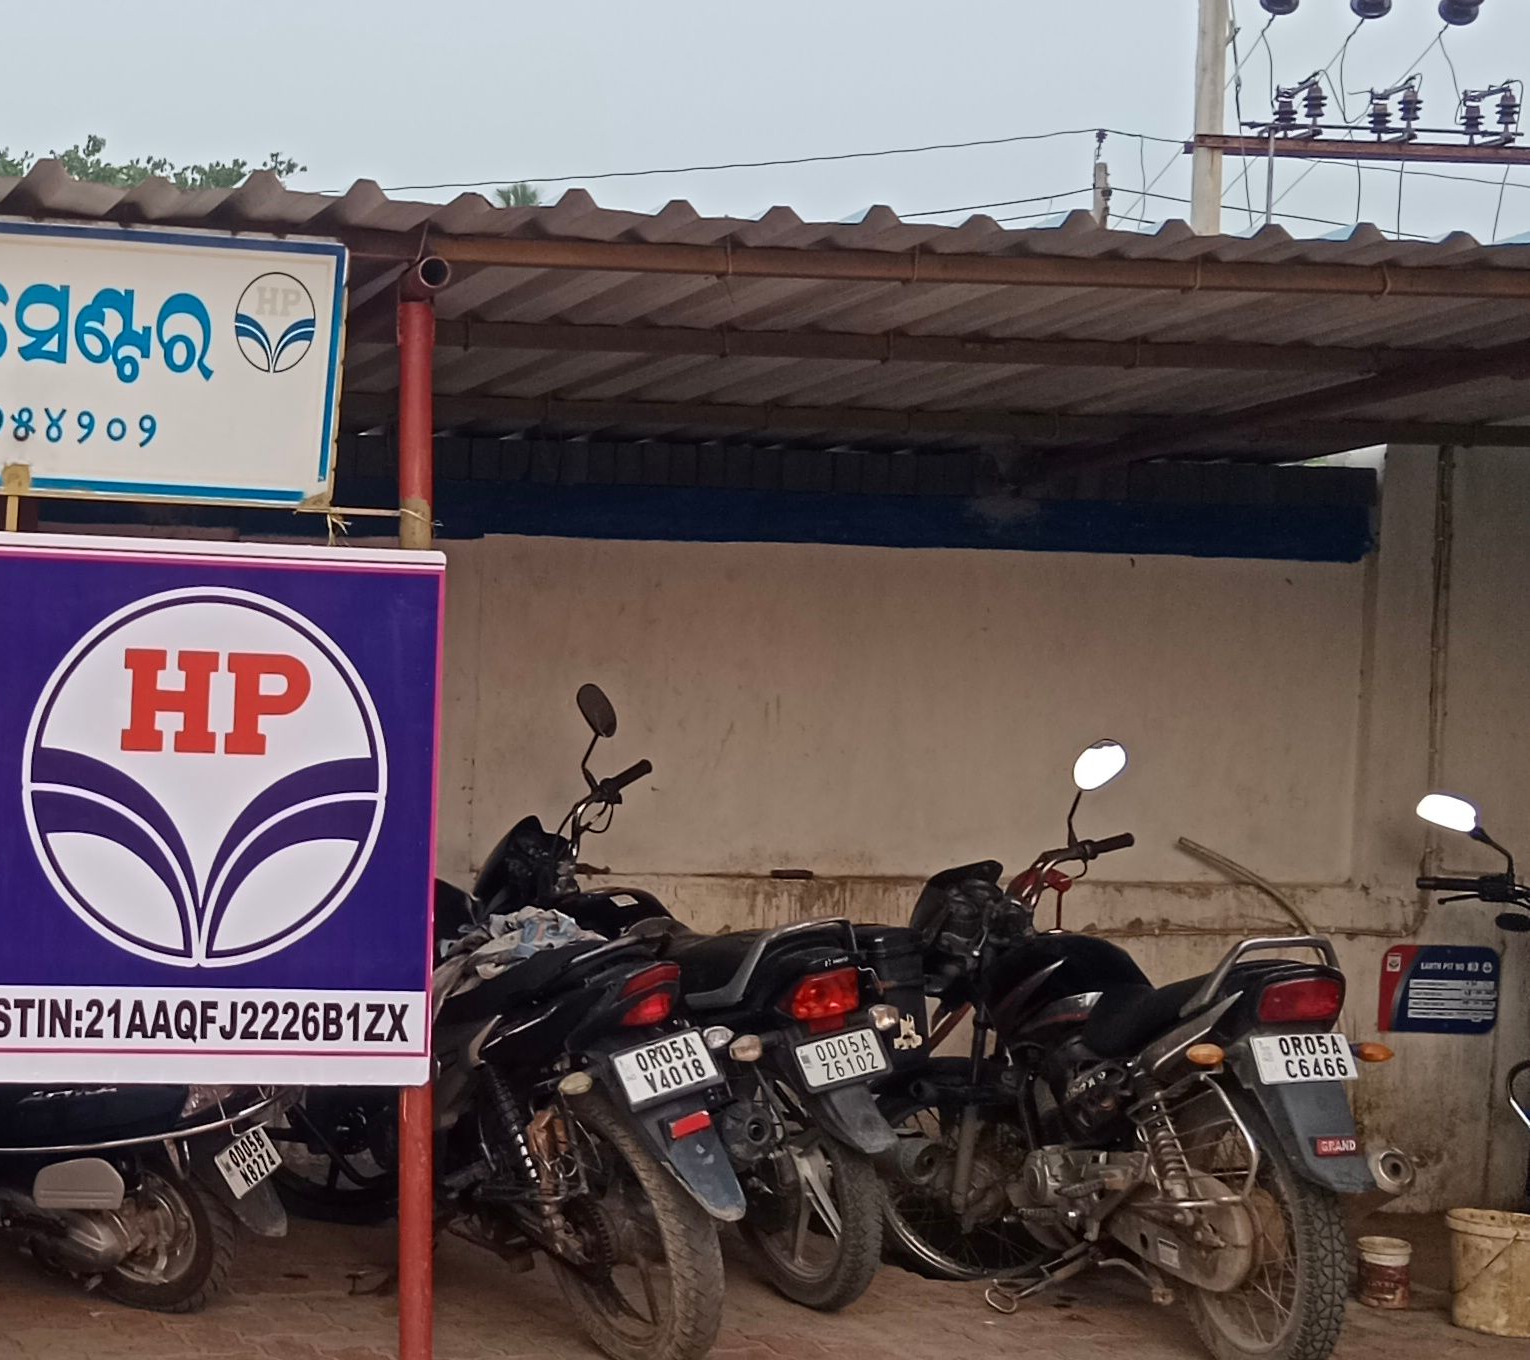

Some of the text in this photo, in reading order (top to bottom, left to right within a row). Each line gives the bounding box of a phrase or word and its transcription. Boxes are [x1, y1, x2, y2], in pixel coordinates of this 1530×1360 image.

[255, 286, 302, 317] HP
[120, 648, 311, 755] HP
[643, 1059, 706, 1093] V4018
[822, 1052, 879, 1081] Z6102
[1285, 1057, 1349, 1079] C6466
[1321, 1139, 1357, 1152] GRAND
